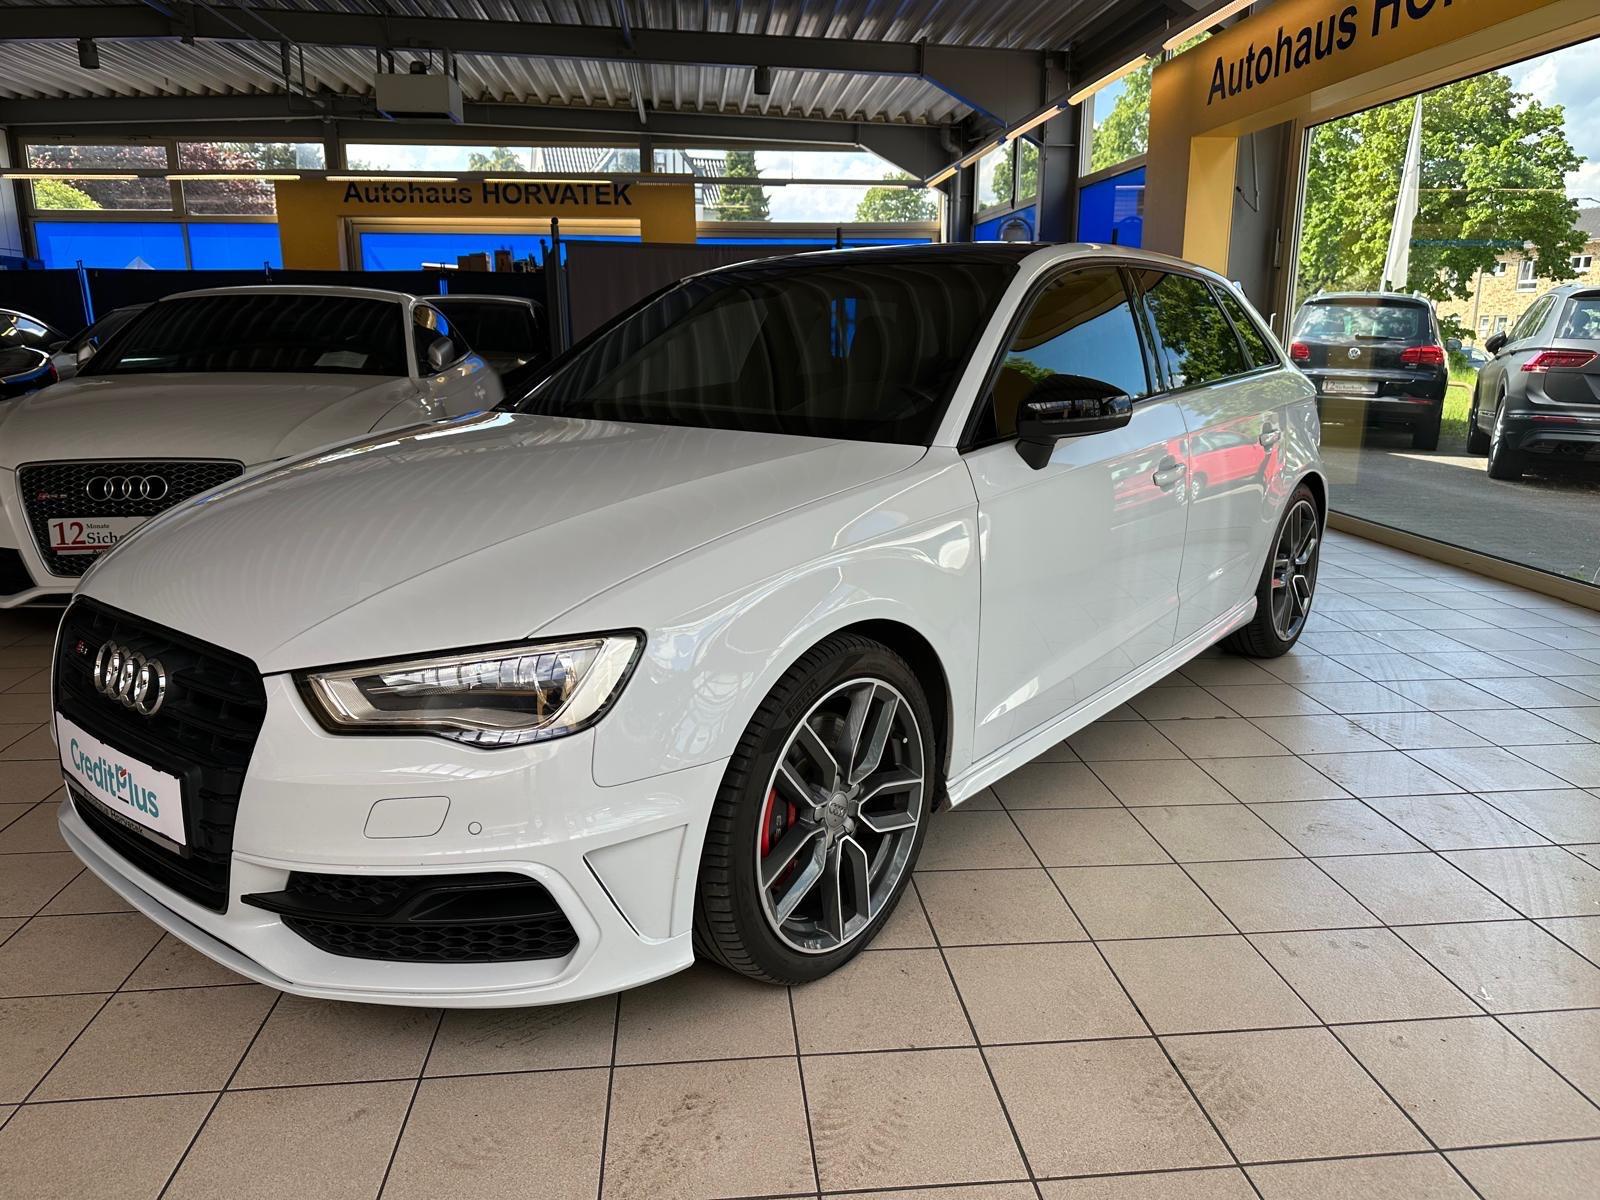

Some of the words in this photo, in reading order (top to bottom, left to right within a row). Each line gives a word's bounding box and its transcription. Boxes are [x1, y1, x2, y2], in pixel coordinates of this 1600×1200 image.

[1206, 2, 1357, 106] Autohaus
[343, 181, 473, 205] Autohaus
[482, 182, 633, 206] HORVATEK
[52, 521, 87, 546] 12
[70, 737, 160, 819] CreditPlus
